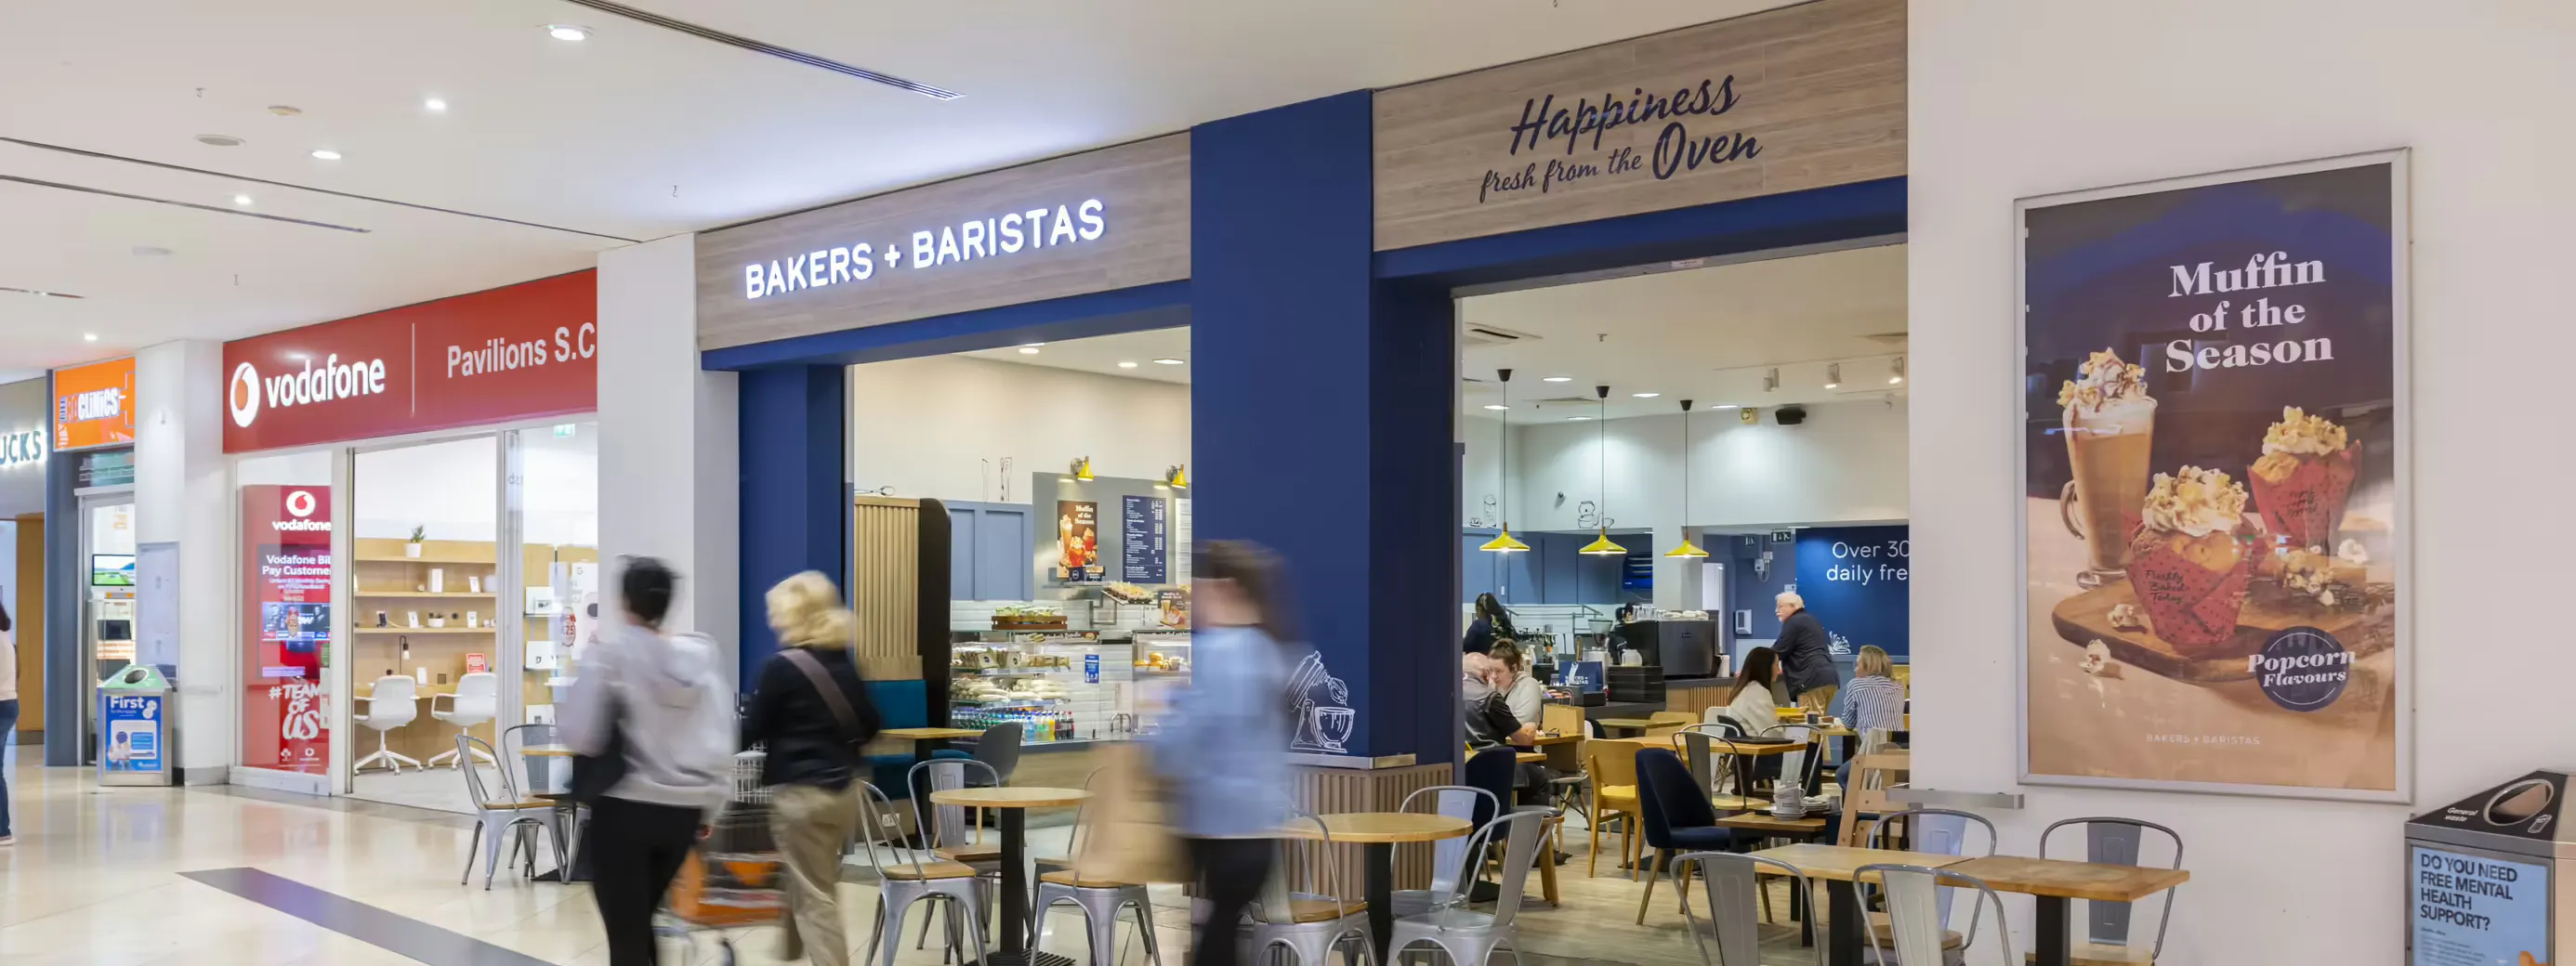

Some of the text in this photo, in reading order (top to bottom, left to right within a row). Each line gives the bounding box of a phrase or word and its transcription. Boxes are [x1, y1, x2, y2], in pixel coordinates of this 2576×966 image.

[1510, 74, 1741, 155] Happiness
[1479, 122, 1764, 203] fresh from the Oven
[745, 199, 1106, 299] BAKERS + BARISTAS
[2168, 251, 2326, 298] Muffin
[2189, 297, 2306, 333] of the
[448, 337, 546, 378] Pavilions
[2166, 337, 2334, 372] Season
[265, 354, 386, 408] vodafone
[271, 518, 331, 530] vodafone
[266, 554, 316, 565] Vodafone
[1832, 540, 1910, 558] Over 30
[262, 565, 282, 577] Pay
[1826, 564, 1908, 586] daily fre
[2245, 651, 2356, 675] Popcorn
[2262, 671, 2346, 687] Flavours
[110, 696, 145, 709] First
[269, 683, 321, 700] #TEAM
[288, 698, 310, 714] OF
[2146, 733, 2190, 743] BAKERS
[2202, 735, 2261, 745] BARISTAS
[2447, 806, 2479, 816] General
[2420, 854, 2517, 882] DO YOU NEED
[2420, 870, 2514, 900] FREE MENTAL
[2420, 887, 2472, 910] HEALTH
[2420, 904, 2491, 931] SUPPORT?
